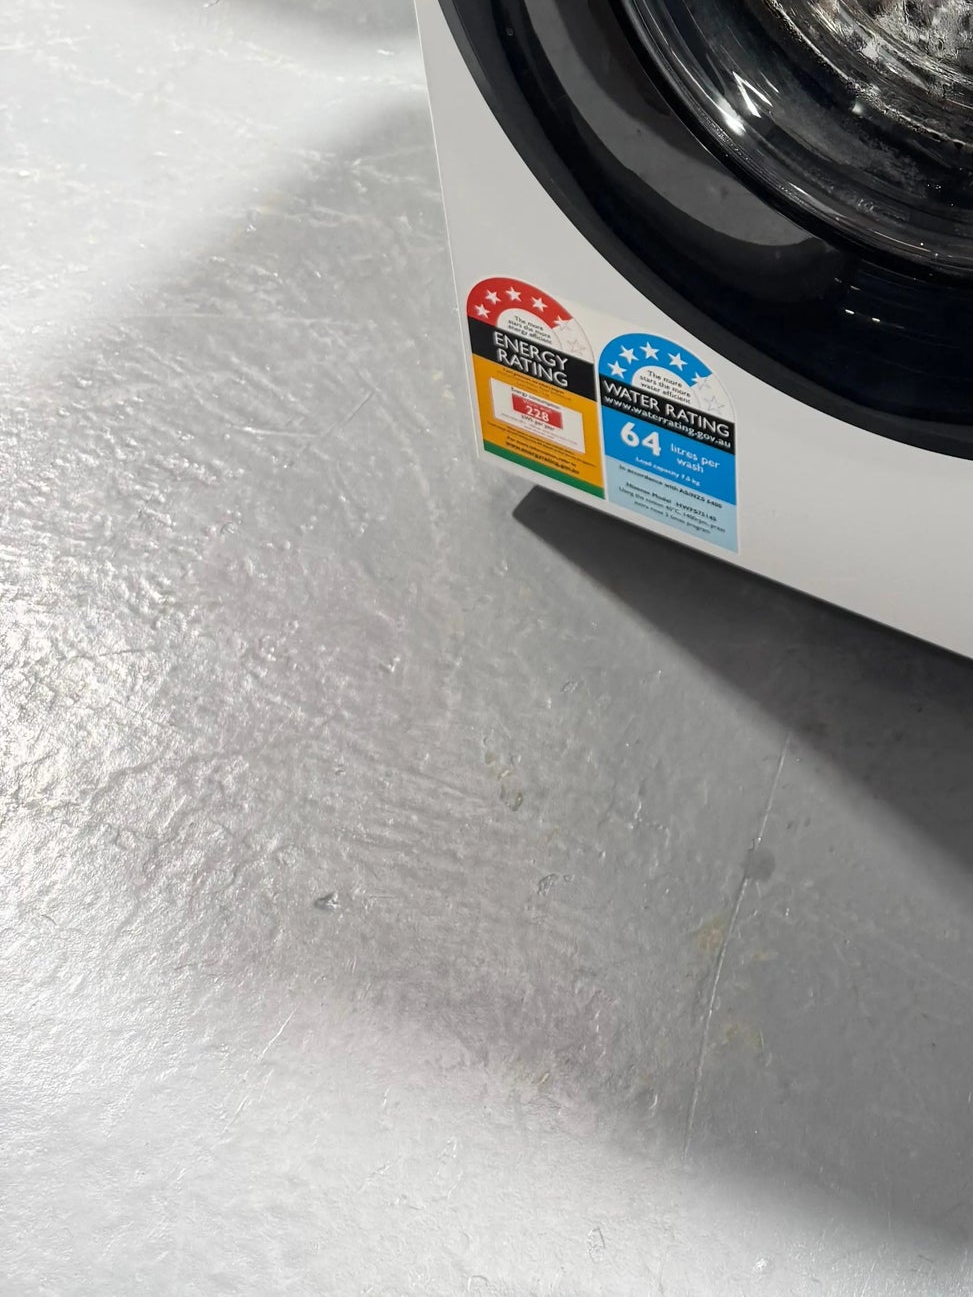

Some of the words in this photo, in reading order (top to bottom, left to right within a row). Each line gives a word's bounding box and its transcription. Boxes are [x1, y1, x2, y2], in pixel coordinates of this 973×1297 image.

[493, 331, 568, 370] ENERGY
[497, 348, 568, 387] RATING
[647, 369, 660, 379] The
[525, 405, 549, 422] 228
[604, 380, 660, 412] WATER
[665, 403, 730, 438] RATING
[604, 395, 731, 448] www.waterrating.gov.au
[620, 422, 662, 456] 64
[670, 443, 698, 461] litres
[701, 456, 721, 469] per
[676, 458, 704, 473] wash
